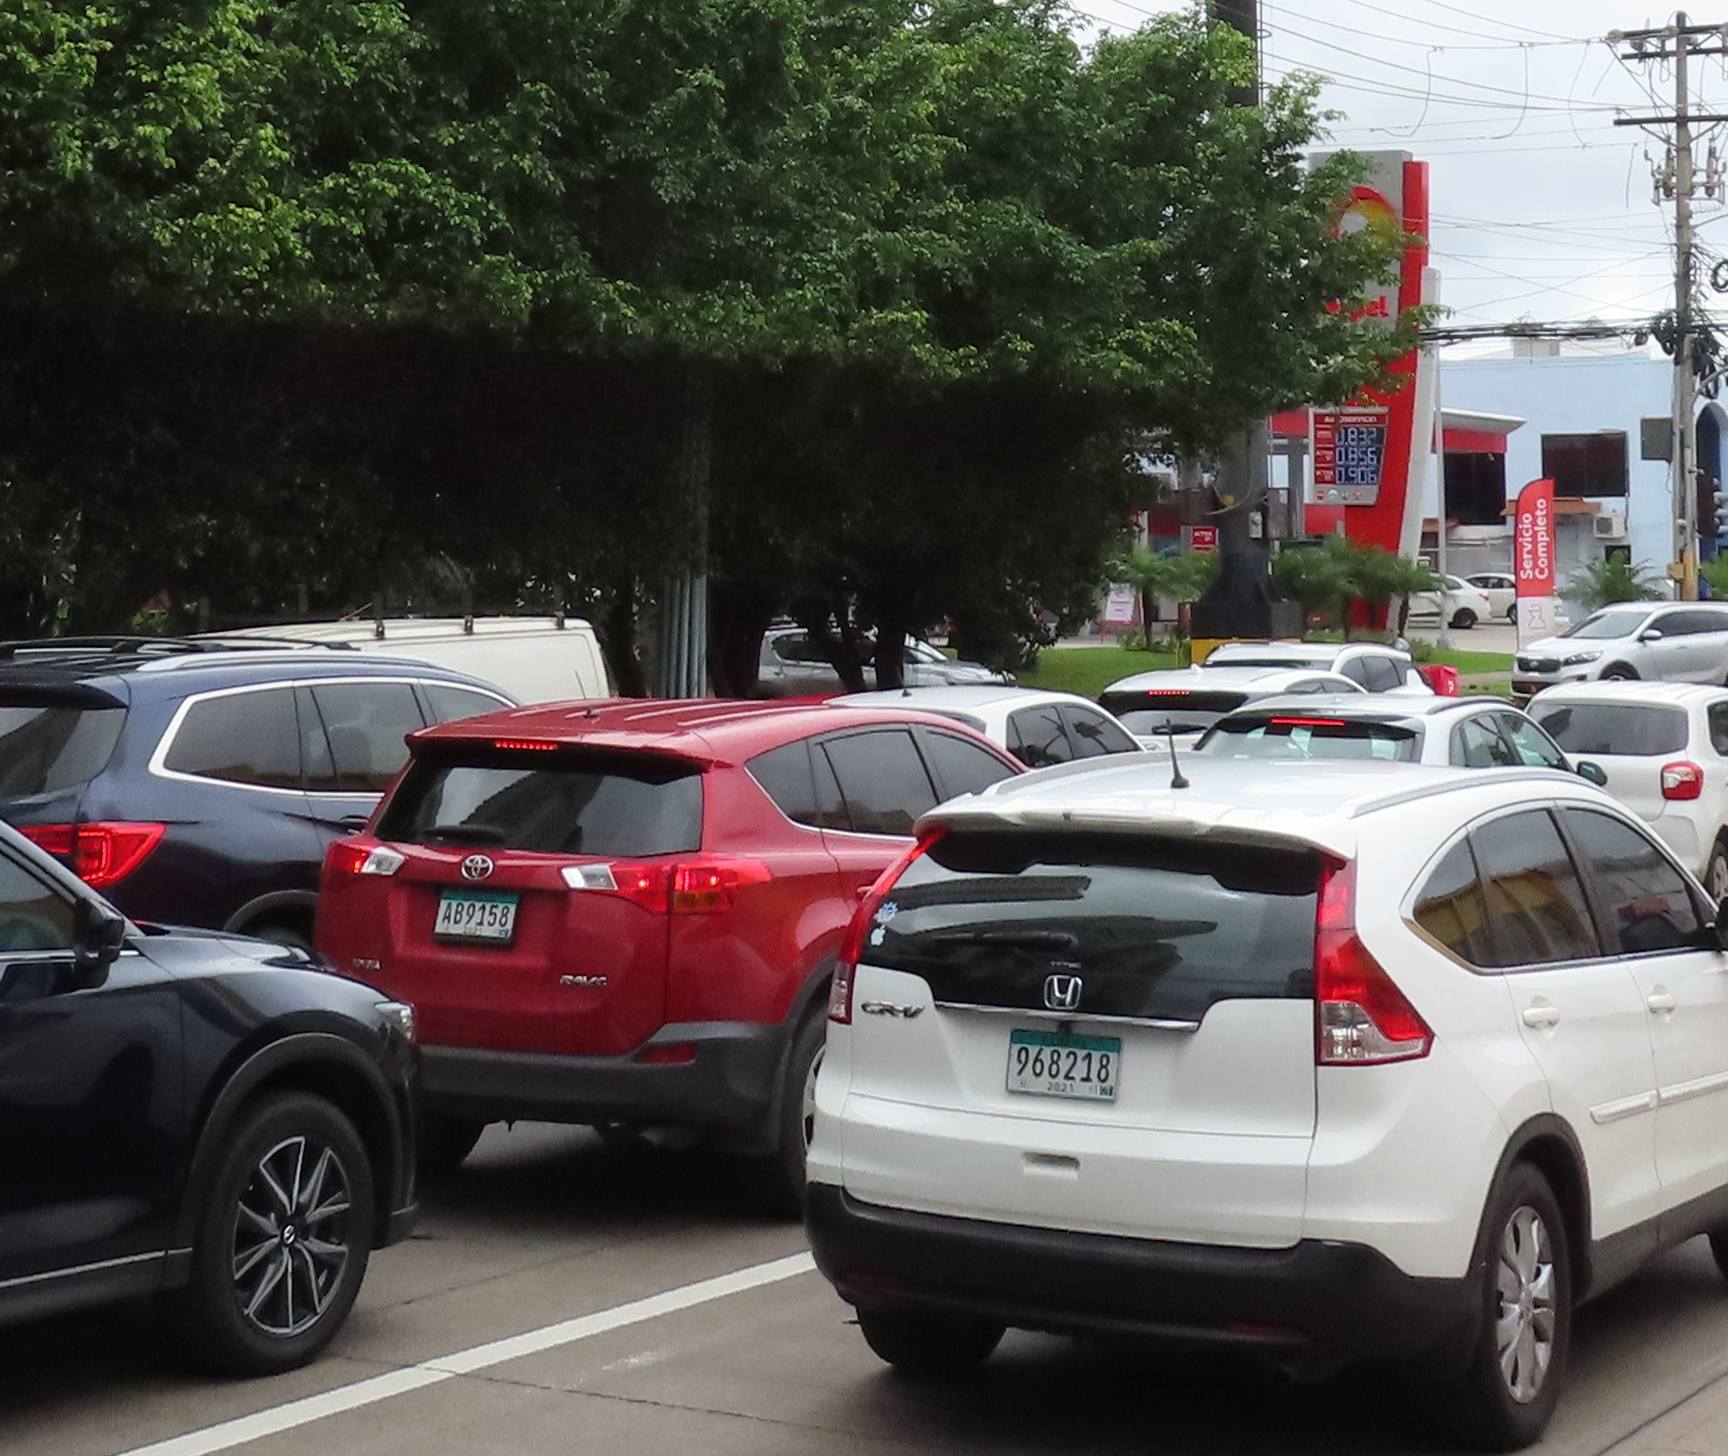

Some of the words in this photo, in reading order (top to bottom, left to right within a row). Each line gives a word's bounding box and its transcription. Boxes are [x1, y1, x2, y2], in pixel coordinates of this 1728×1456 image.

[1518, 513, 1533, 580] Servicio
[1534, 498, 1550, 580] Completo
[442, 902, 510, 928] AB9158
[1016, 1046, 1111, 1084] 968218
